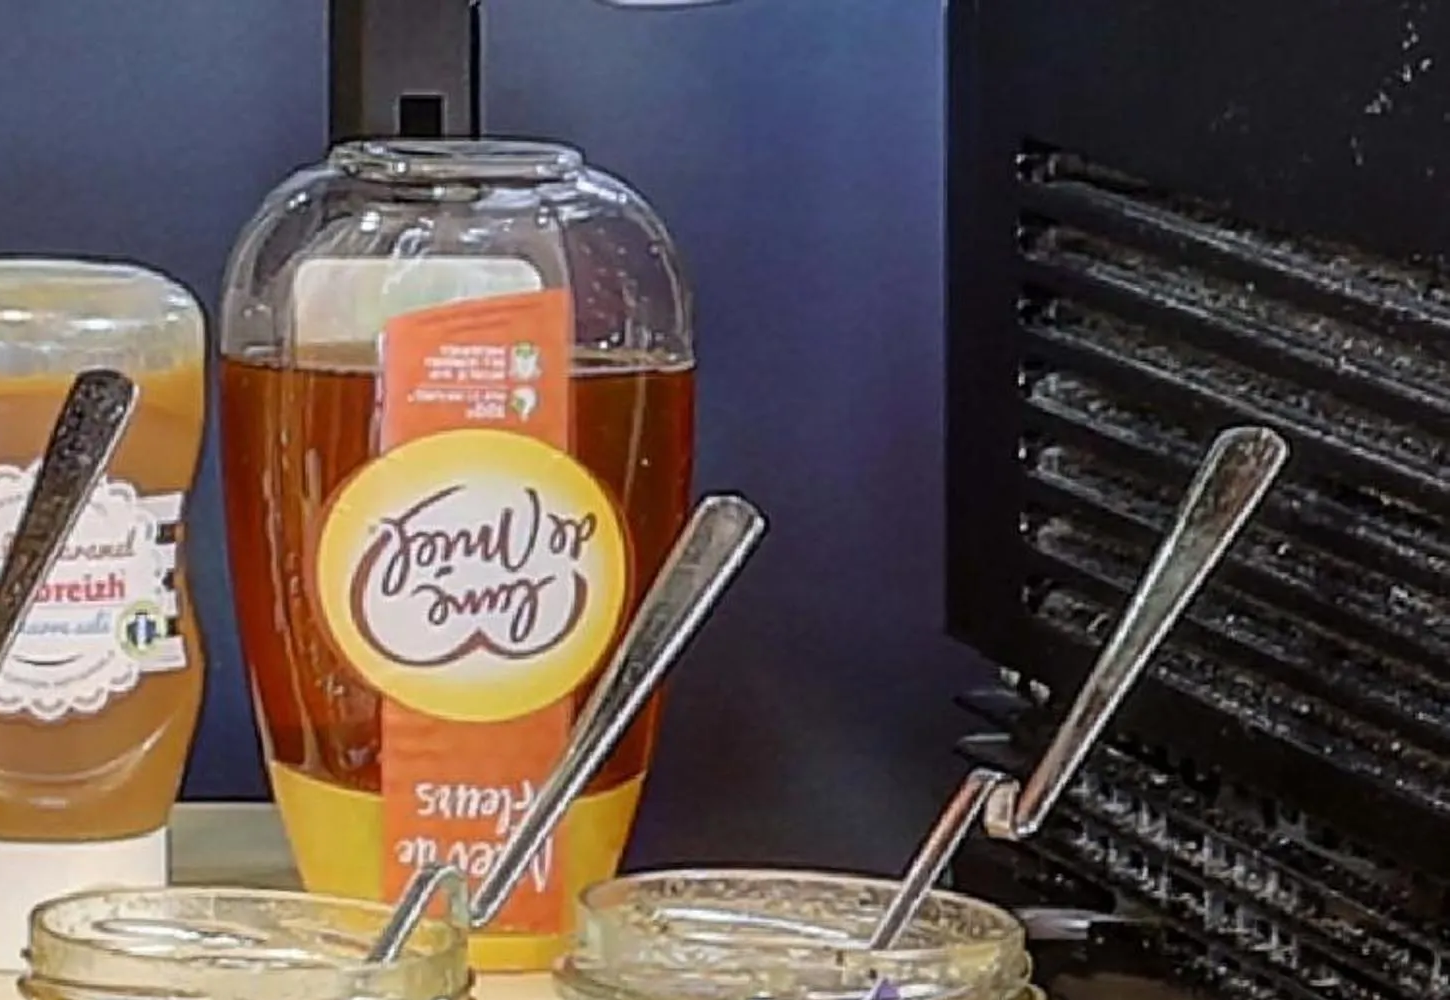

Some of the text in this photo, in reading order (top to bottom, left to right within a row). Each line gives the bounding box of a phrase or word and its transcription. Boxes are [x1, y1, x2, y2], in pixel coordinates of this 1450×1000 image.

[379, 486, 597, 597] de Miel
[410, 576, 555, 643] lune
